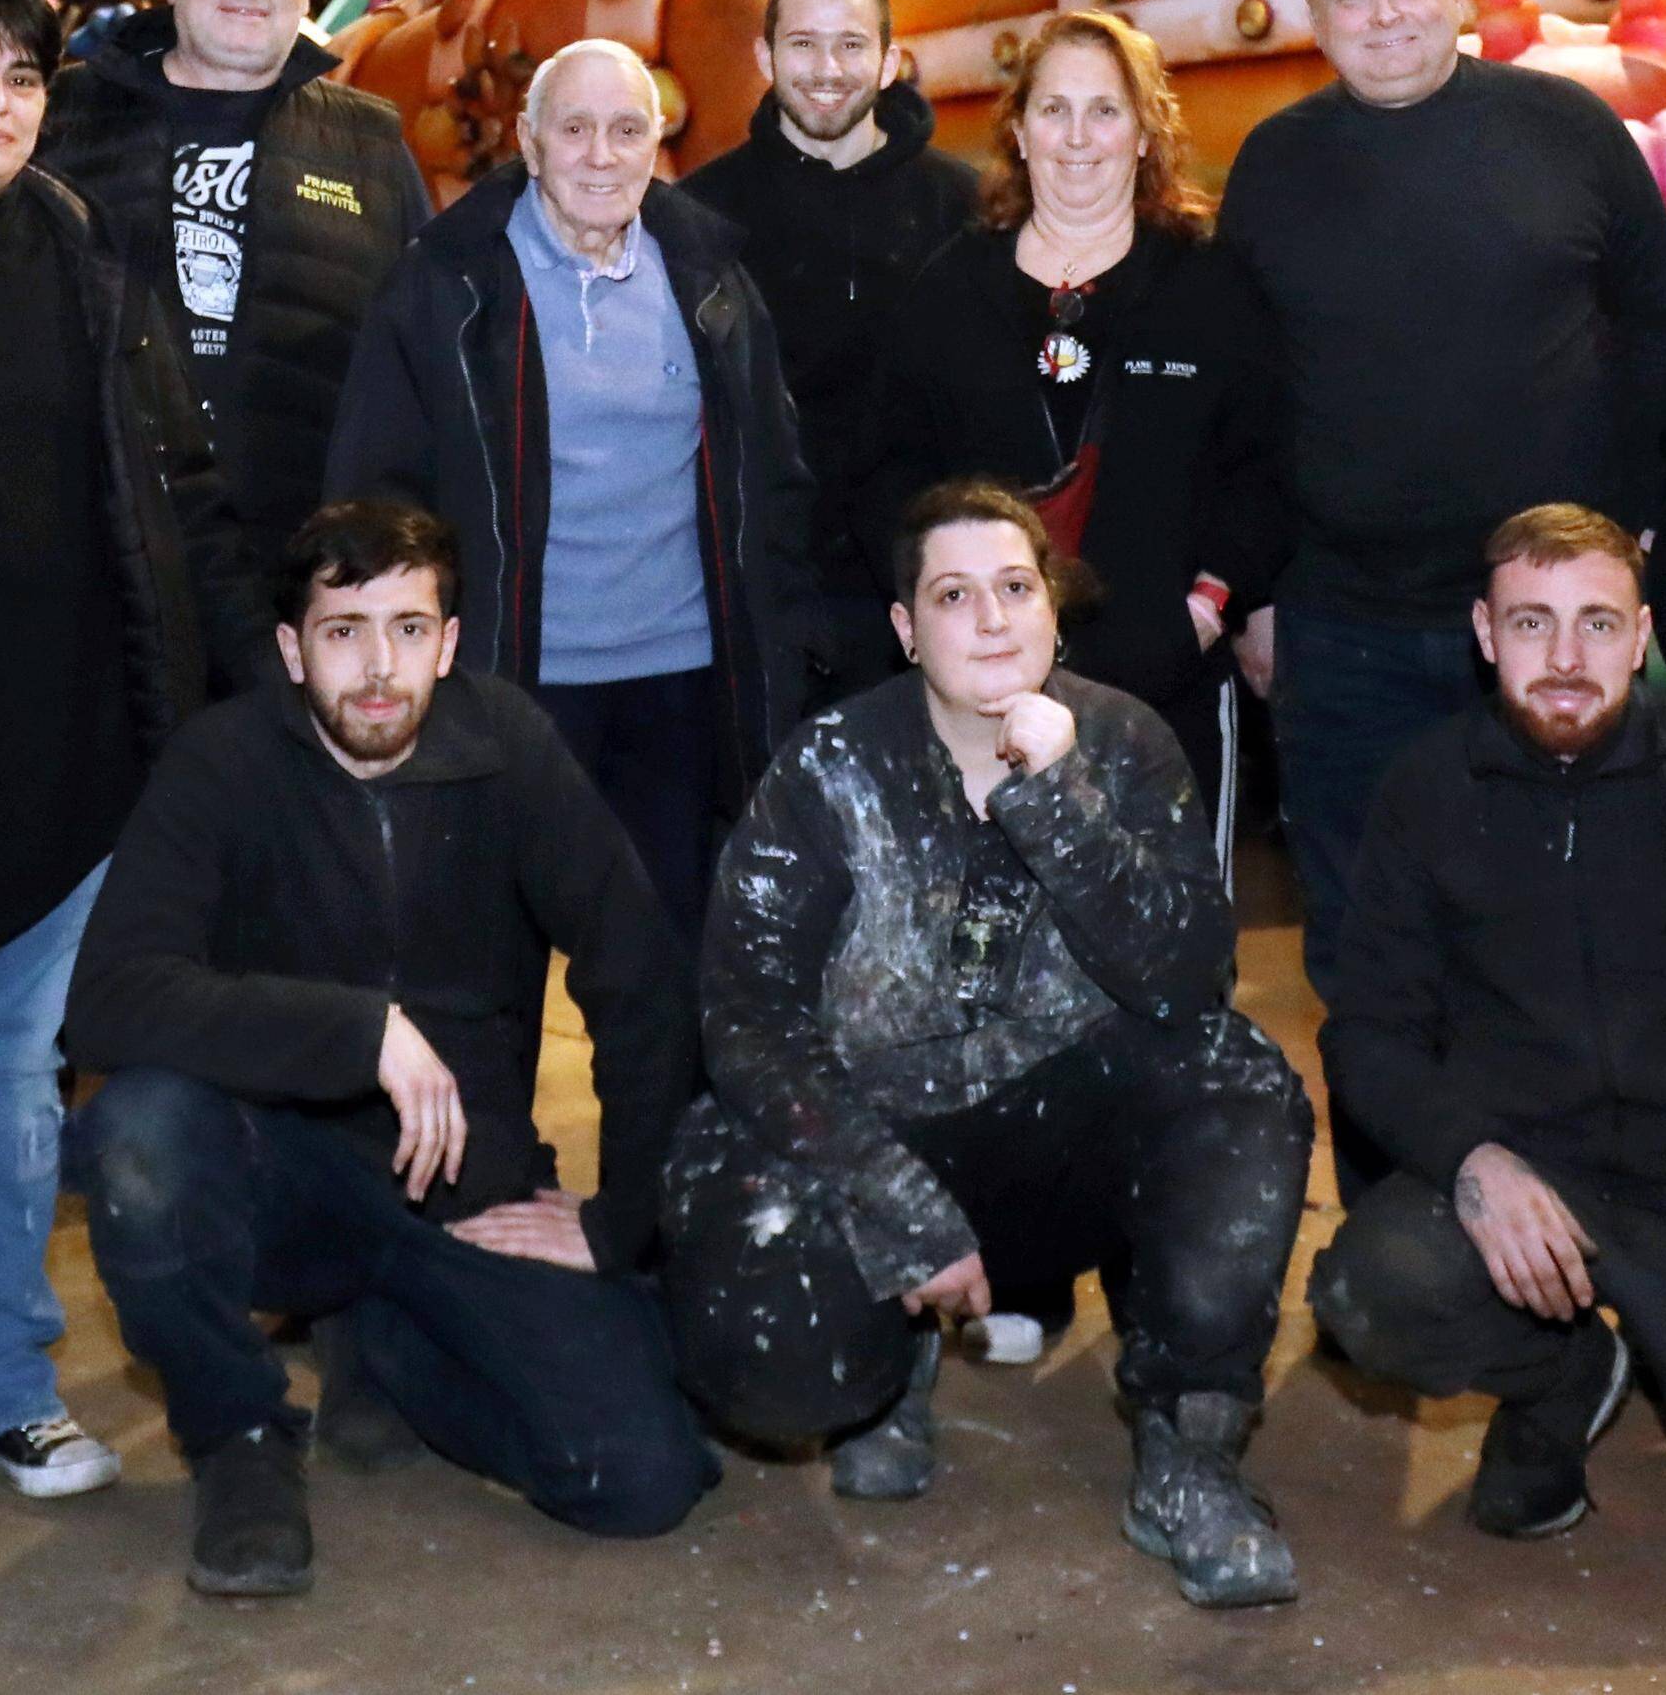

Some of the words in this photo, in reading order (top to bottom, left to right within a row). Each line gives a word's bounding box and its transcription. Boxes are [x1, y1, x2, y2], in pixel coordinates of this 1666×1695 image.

[304, 174, 354, 195] FRANCE
[190, 328, 227, 342] ASTER
[193, 342, 227, 356] OKLYN
